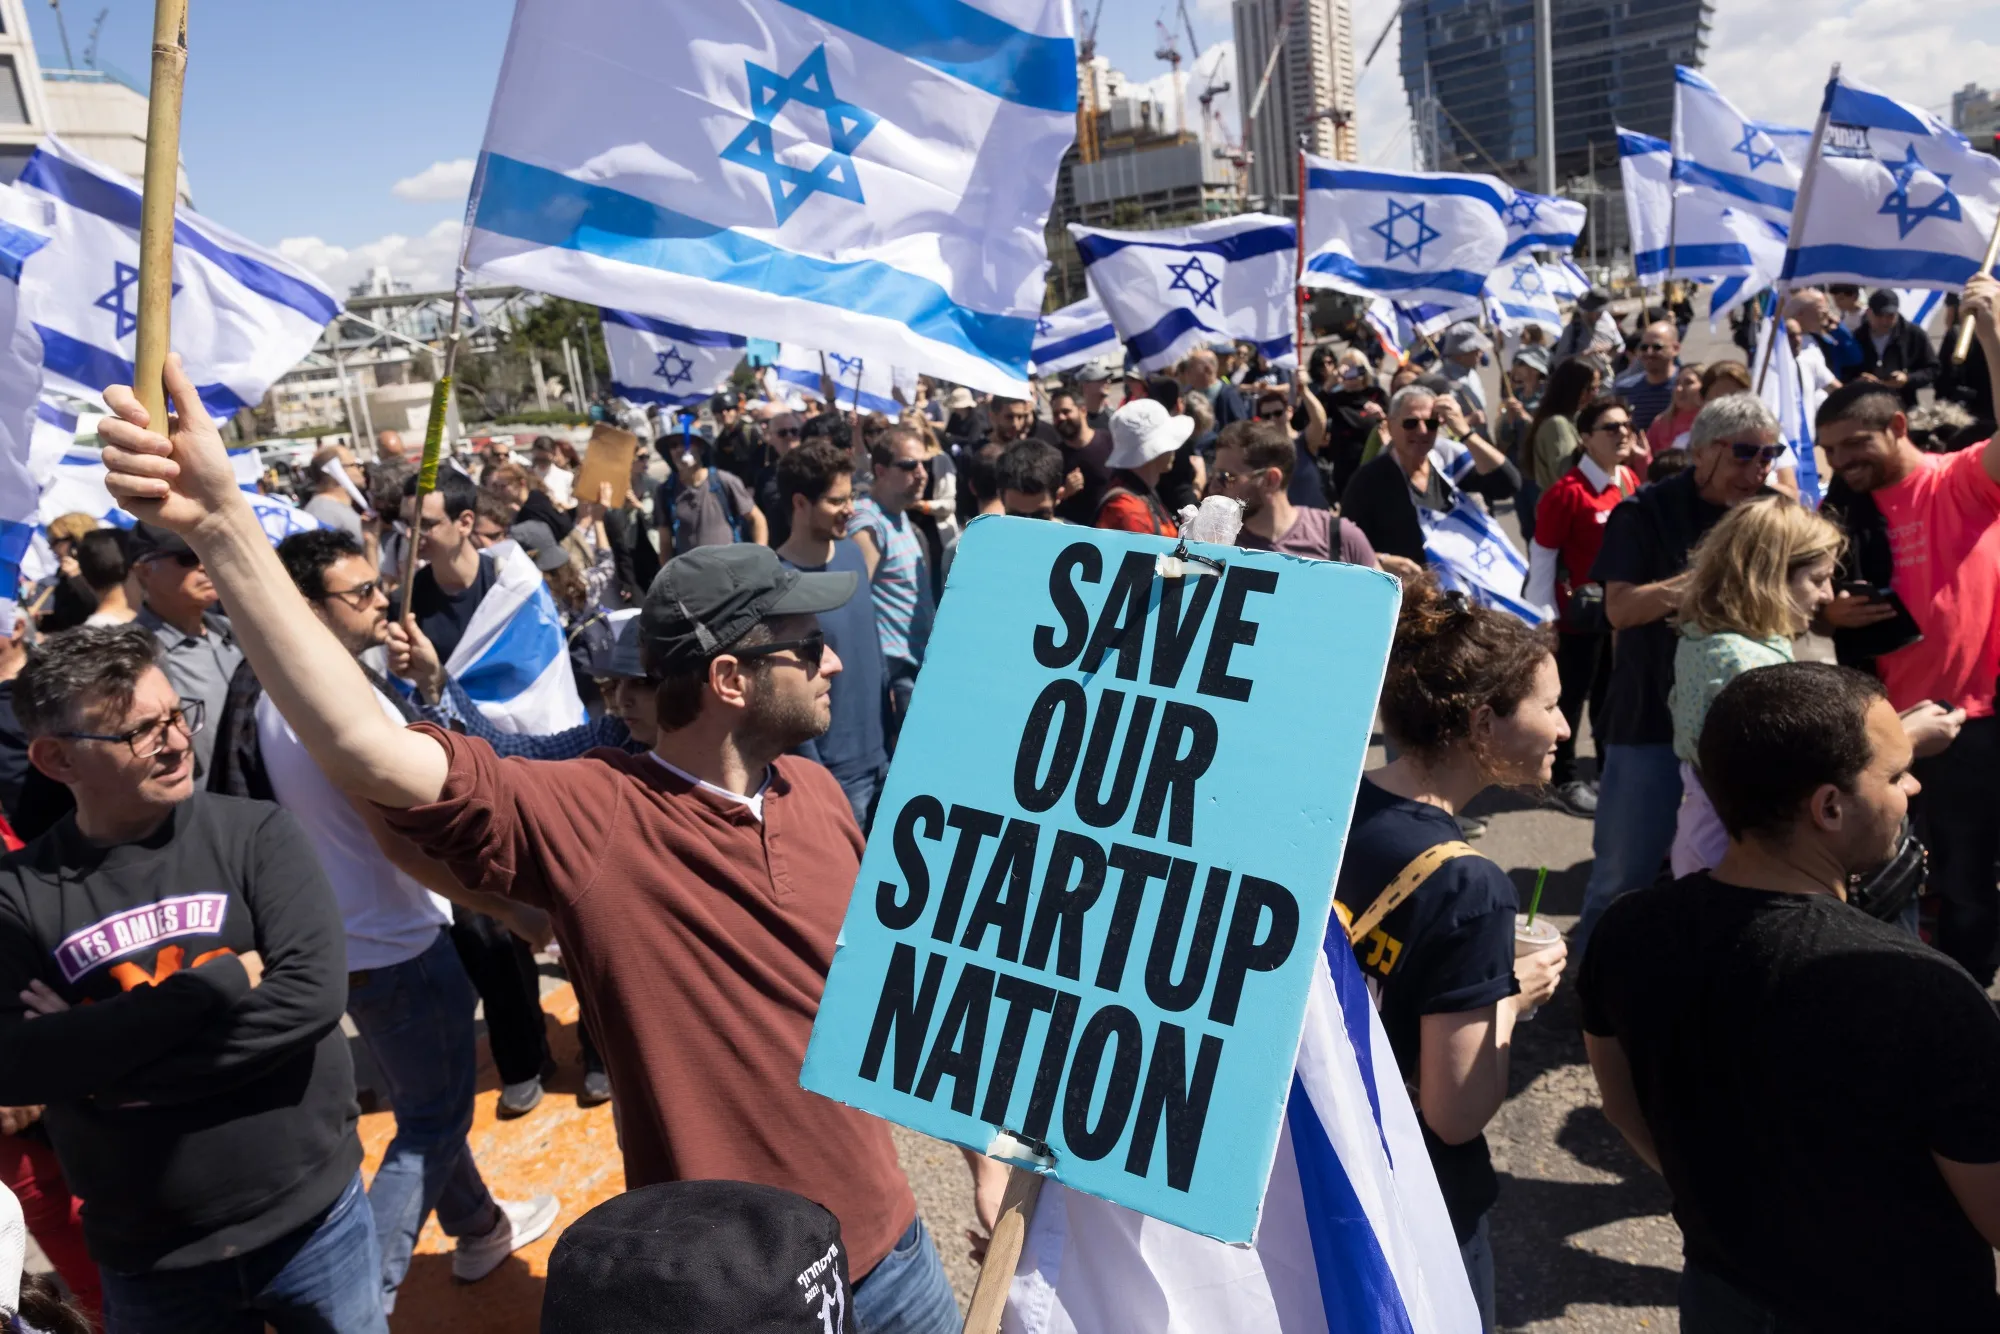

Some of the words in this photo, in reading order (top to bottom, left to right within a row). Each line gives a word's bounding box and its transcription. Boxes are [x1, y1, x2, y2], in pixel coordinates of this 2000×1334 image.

[1034, 543, 1279, 703] SAVE
[1014, 679, 1219, 847] OUR
[70, 930, 112, 968] LES
[113, 905, 179, 948] AMIES
[186, 900, 212, 928] DE
[876, 795, 1299, 1027] STARTUP
[858, 943, 1224, 1193] NATION
